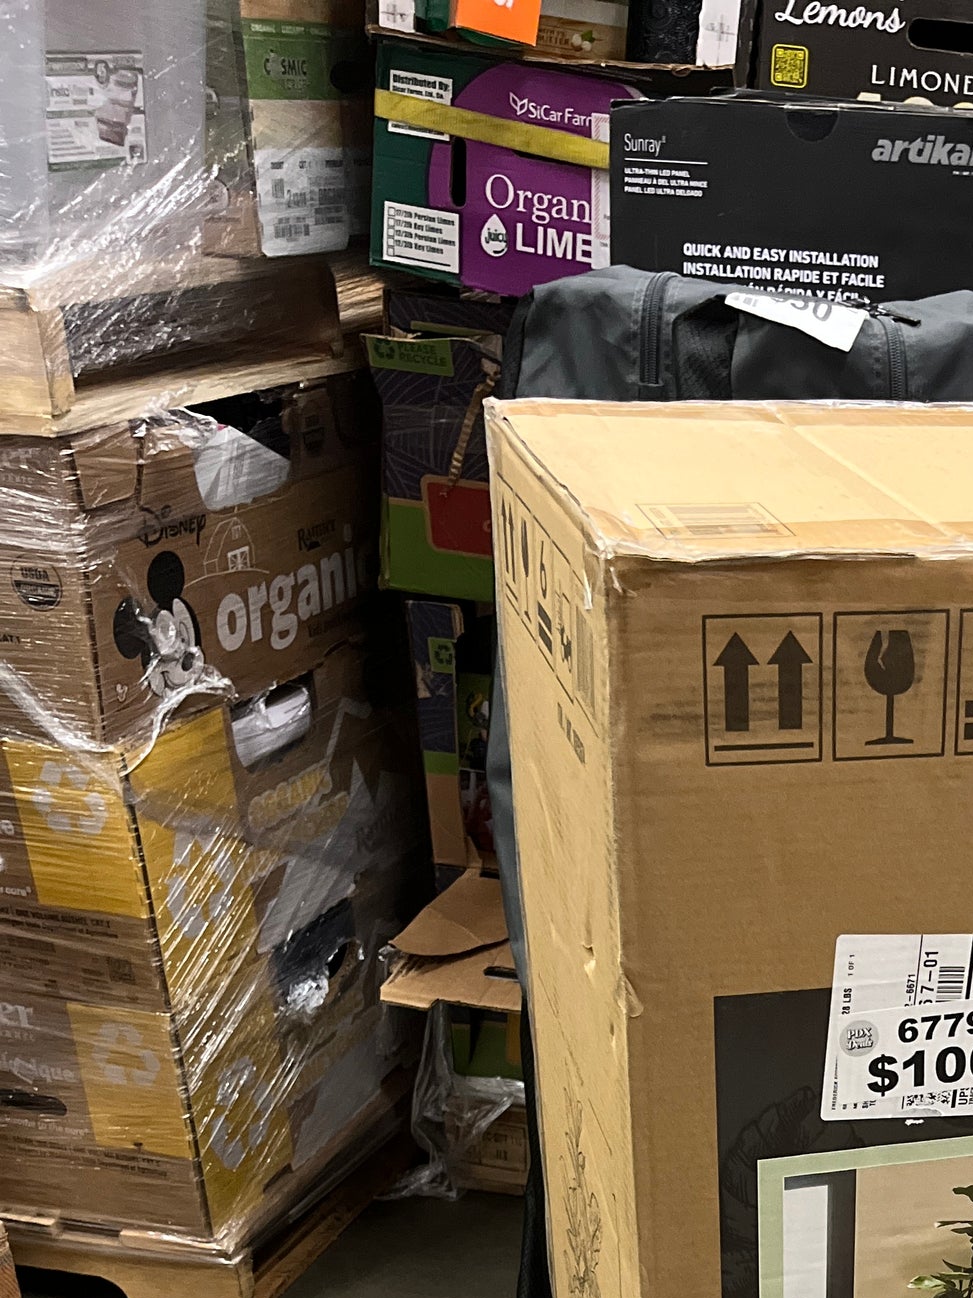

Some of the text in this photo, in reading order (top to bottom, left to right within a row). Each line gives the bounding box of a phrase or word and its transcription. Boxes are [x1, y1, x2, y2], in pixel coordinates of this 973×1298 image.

[774, 0, 905, 33] Lemons
[392, 74, 437, 90] Distributed
[528, 105, 562, 124] SiCar
[871, 135, 964, 167] artika
[485, 174, 591, 224] Organ
[515, 222, 592, 264] LIME
[683, 243, 879, 268] QUICK AND EASY INSTALLATION
[683, 262, 885, 288] INSTALLATION RAPIDE ET FACILE
[844, 988, 853, 1003] LBS
[847, 1027, 873, 1040] PDX
